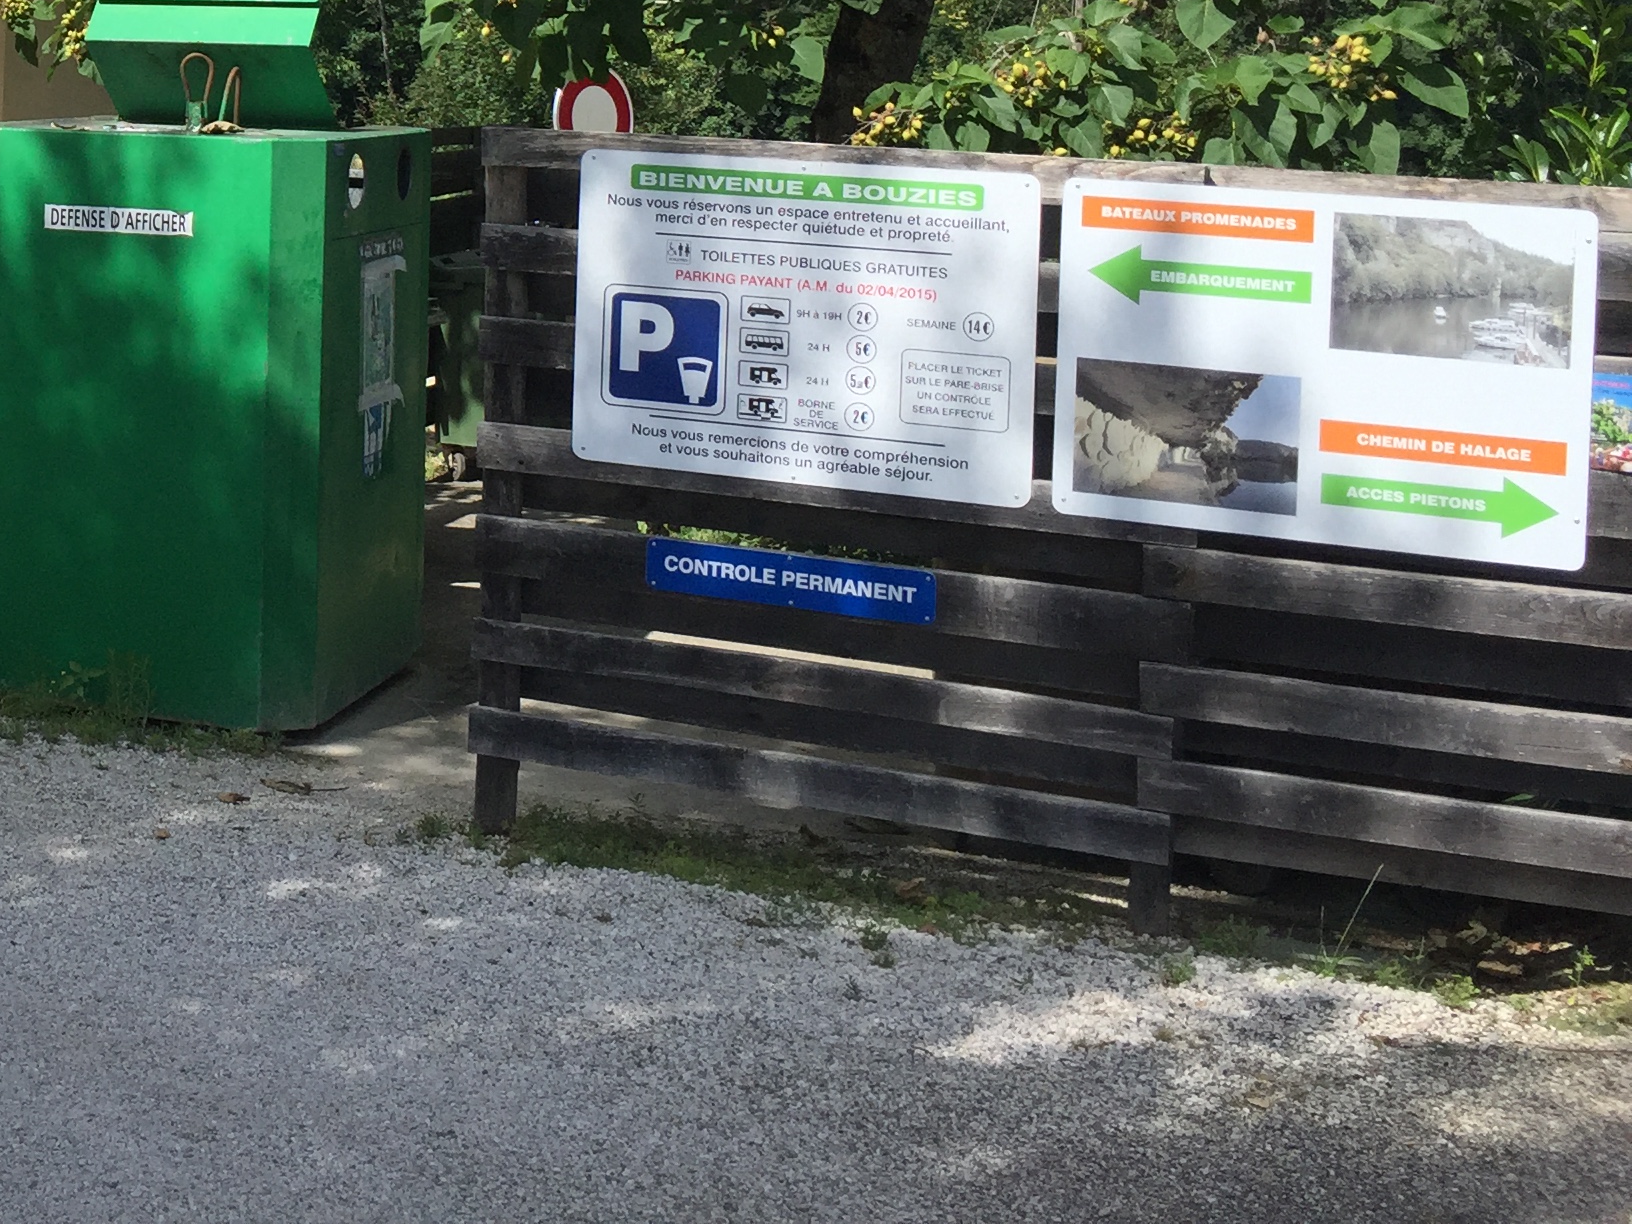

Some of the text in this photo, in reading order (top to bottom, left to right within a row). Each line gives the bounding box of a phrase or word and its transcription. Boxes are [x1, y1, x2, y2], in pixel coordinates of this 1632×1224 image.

[639, 170, 977, 207] BIENVENUE A BOUZIES
[50, 207, 187, 233] DEFENSE D'AFFICHER
[607, 193, 1011, 234] Nous vous réservons un espace entretenu et accueillant,
[655, 212, 693, 225] merci
[697, 214, 728, 227] d'en
[731, 218, 798, 233] respecter
[802, 221, 866, 237] quiétude
[869, 226, 884, 239] et
[1100, 205, 1298, 231] BATEAUX PROMENADES
[700, 249, 949, 279] TOILETTES PUBLIQUES GRATUITES
[675, 269, 736, 286] PARKING
[740, 274, 793, 290] PAYANT
[835, 281, 853, 295] du
[856, 284, 938, 303] 02/04/2015)
[1150, 269, 1296, 293] EMBARQUEMENT
[618, 299, 675, 372] P
[907, 318, 957, 331] SEMAINE
[807, 342, 820, 352] 24
[822, 343, 830, 352] H
[806, 376, 818, 385] 24
[908, 361, 1003, 378] PLACER LE TICKET
[905, 375, 1005, 393] SUR LE PARE-BRISE
[917, 391, 932, 400] UN
[797, 398, 836, 411] BORNE
[809, 409, 824, 419] DE
[912, 404, 940, 416] SERA
[793, 417, 839, 431] SERVICE
[631, 422, 969, 470] Nous vous remercions de votre compréhension
[1356, 432, 1532, 462] CHEMIN DE HALAGE
[659, 441, 933, 482] et vous souhaitons un agréable séjour.
[1345, 485, 1487, 512] ACCES PIETONS
[663, 555, 918, 604] CONTROLE PERMANENT
